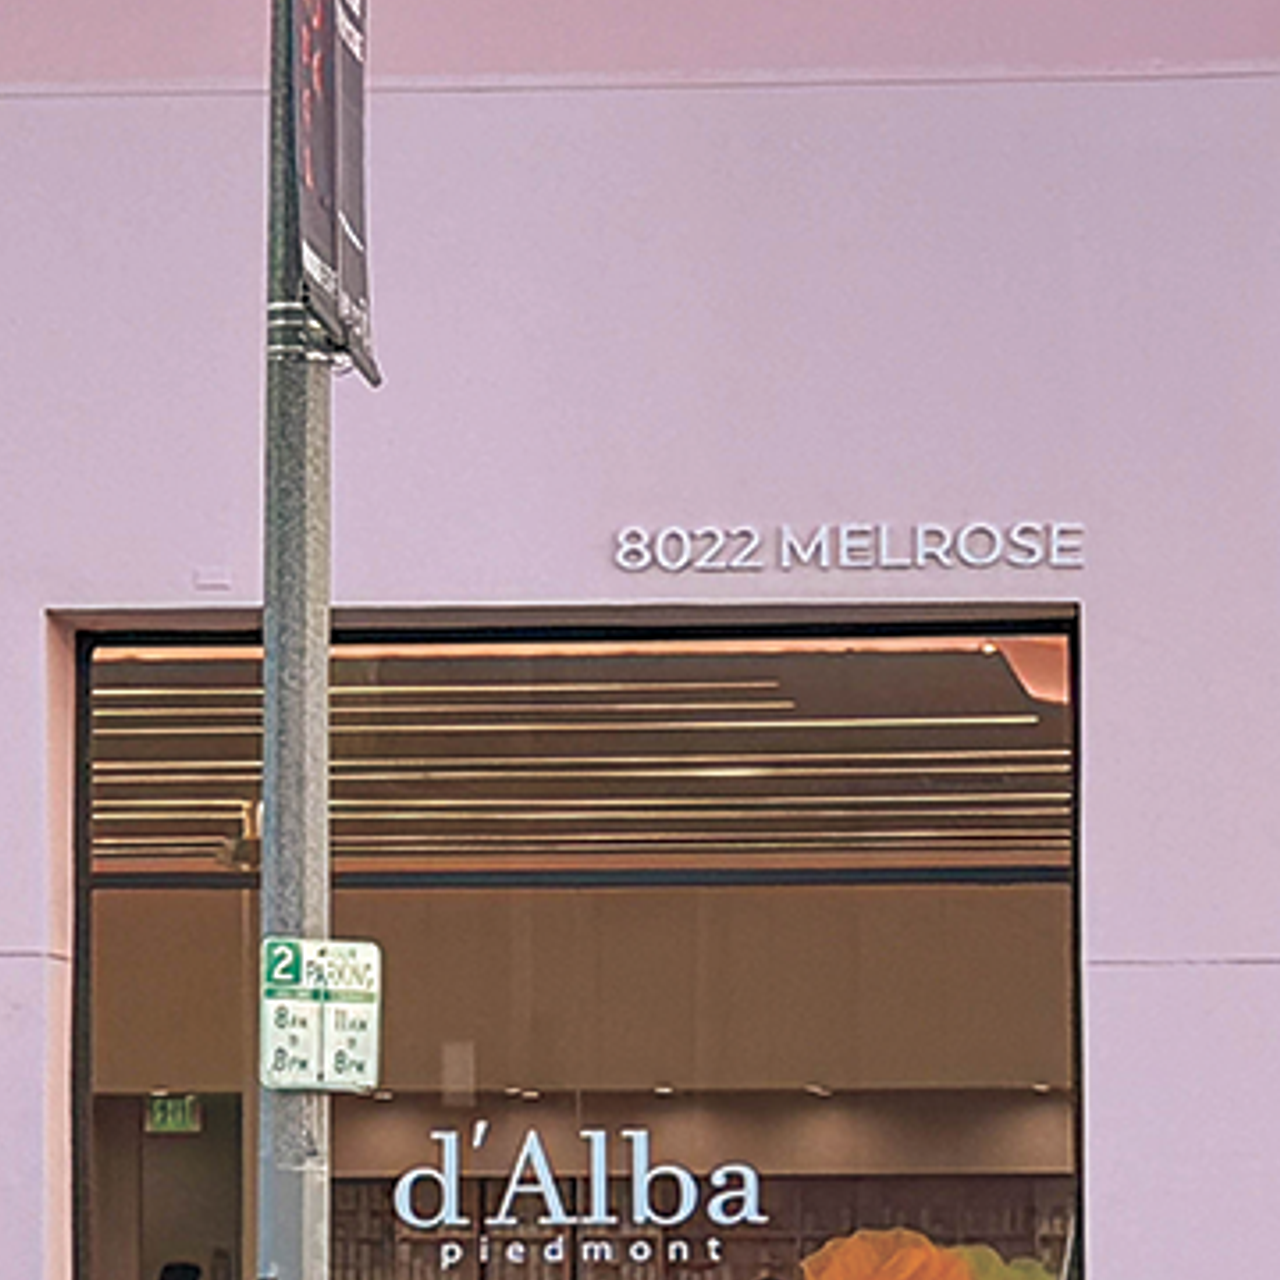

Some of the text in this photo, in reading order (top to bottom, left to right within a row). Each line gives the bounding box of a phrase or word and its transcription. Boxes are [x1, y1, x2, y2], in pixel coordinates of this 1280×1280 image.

[613, 521, 1085, 572] 8022 MELROSE
[273, 945, 294, 980] 2
[393, 1119, 770, 1228] d'Alba
[439, 1234, 722, 1271] piedmont
